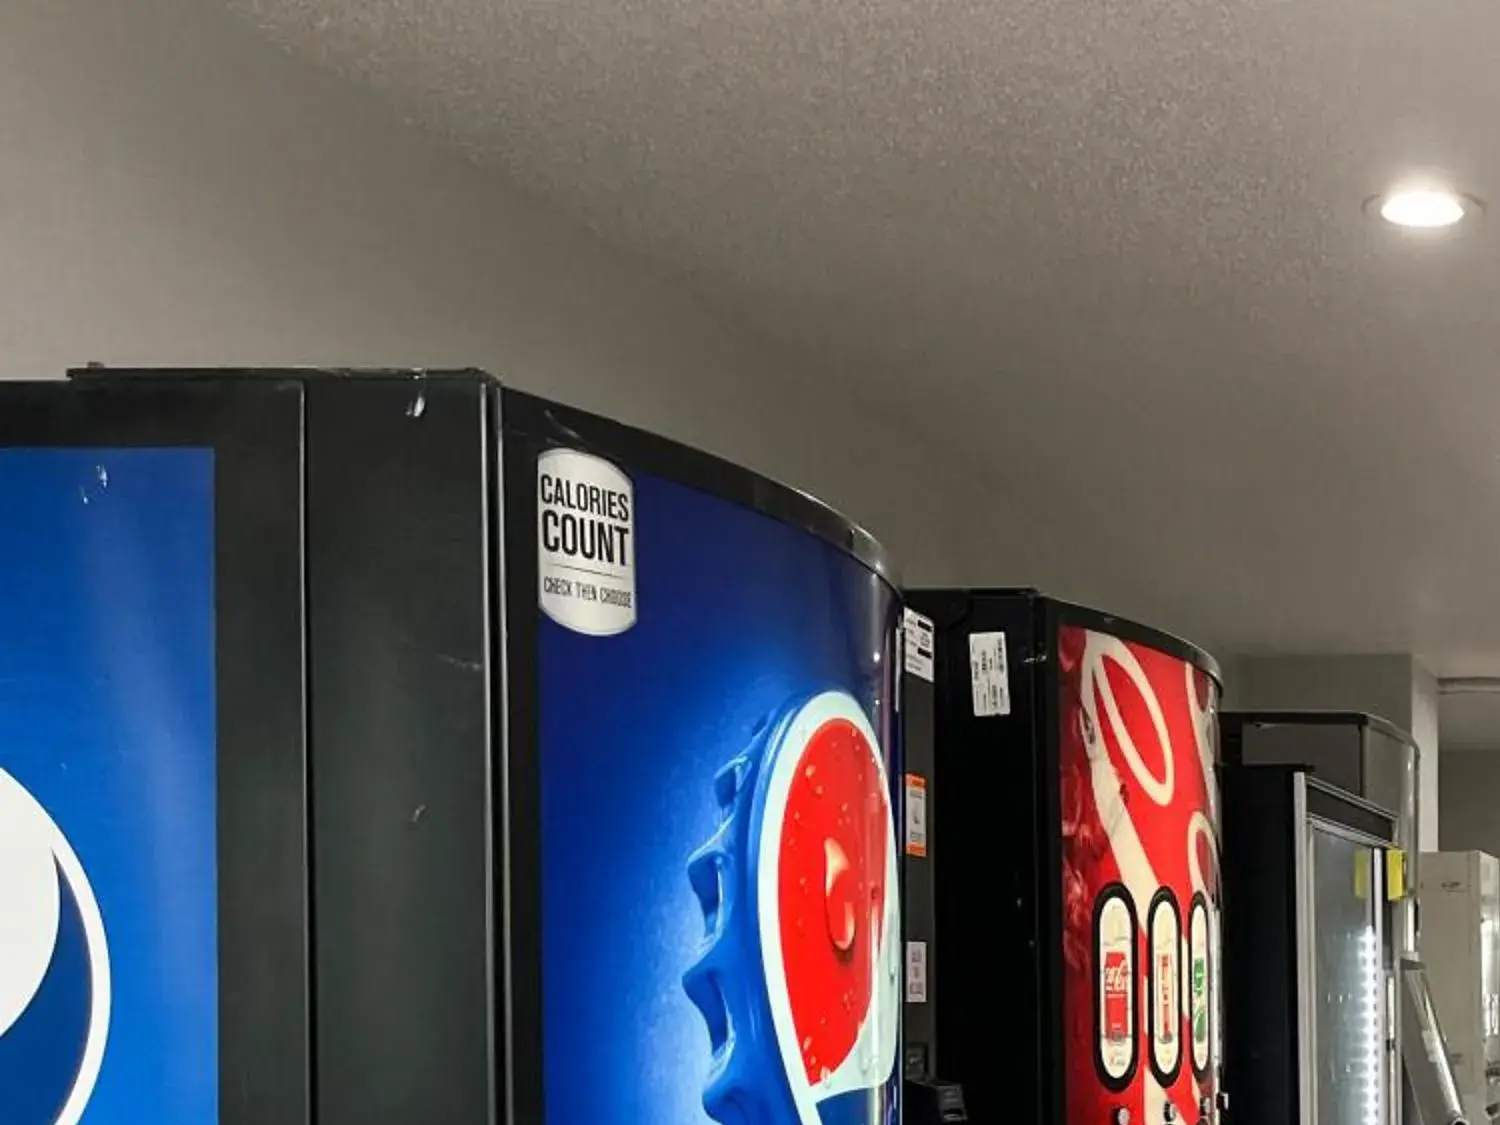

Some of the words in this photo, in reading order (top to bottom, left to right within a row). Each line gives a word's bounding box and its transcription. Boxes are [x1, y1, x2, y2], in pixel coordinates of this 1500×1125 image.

[541, 473, 630, 522] CALORIES
[542, 509, 630, 566] COUNT
[543, 576, 573, 596] CHECK
[575, 582, 597, 601] THEN
[599, 587, 632, 608] CHOOSE
